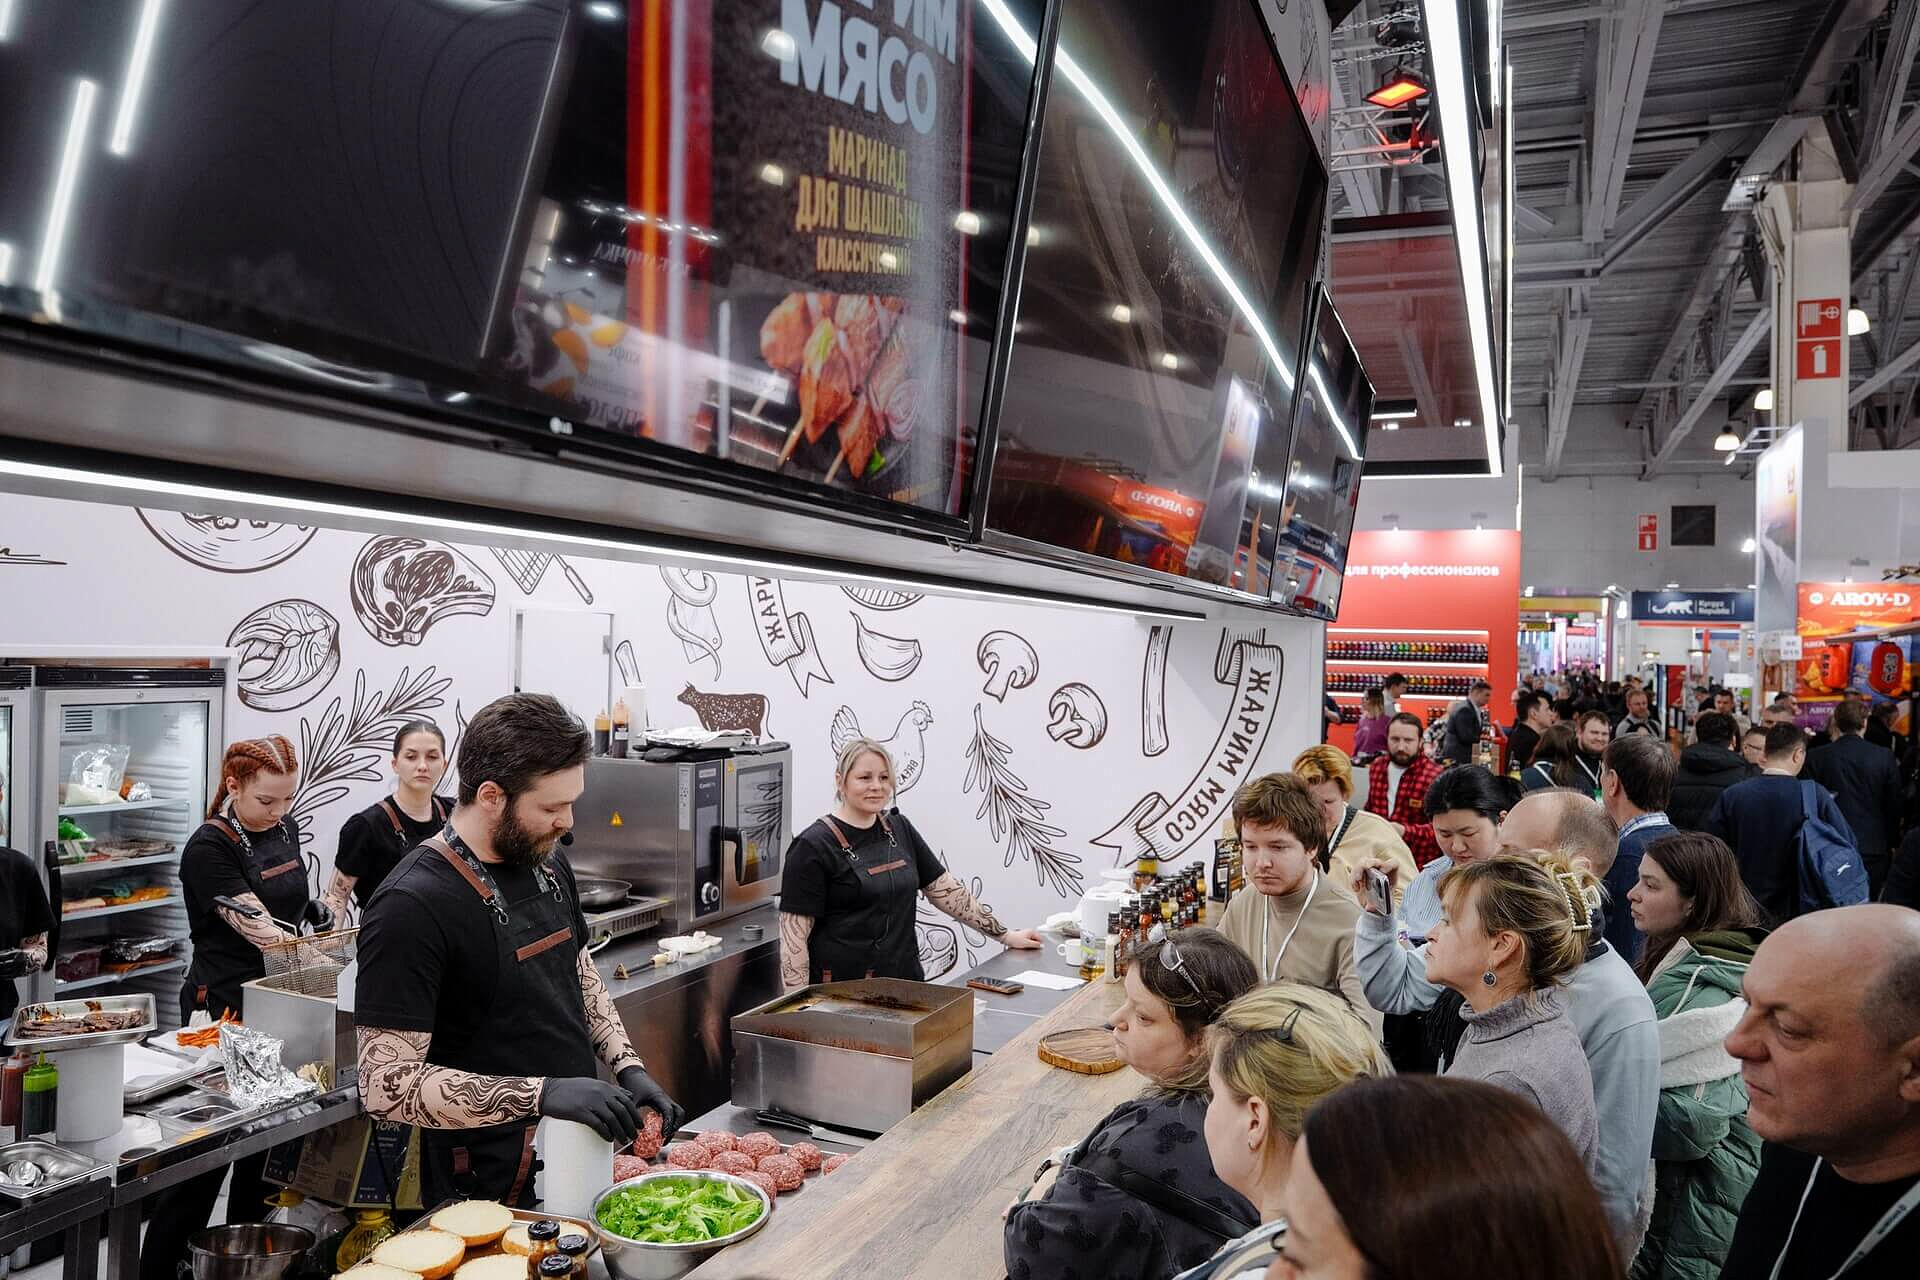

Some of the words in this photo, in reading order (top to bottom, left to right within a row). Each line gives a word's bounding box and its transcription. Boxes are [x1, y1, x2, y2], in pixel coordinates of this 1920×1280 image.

[780, 0, 938, 134] МЯСО
[828, 125, 907, 196] МАРИНАД
[795, 174, 839, 232] ДЛЯ
[1371, 562, 1500, 579] профессионалов
[1830, 591, 1911, 607] AROY-D
[1217, 666, 1272, 777] ЖАРИМ
[1165, 777, 1226, 842] МЯСО
